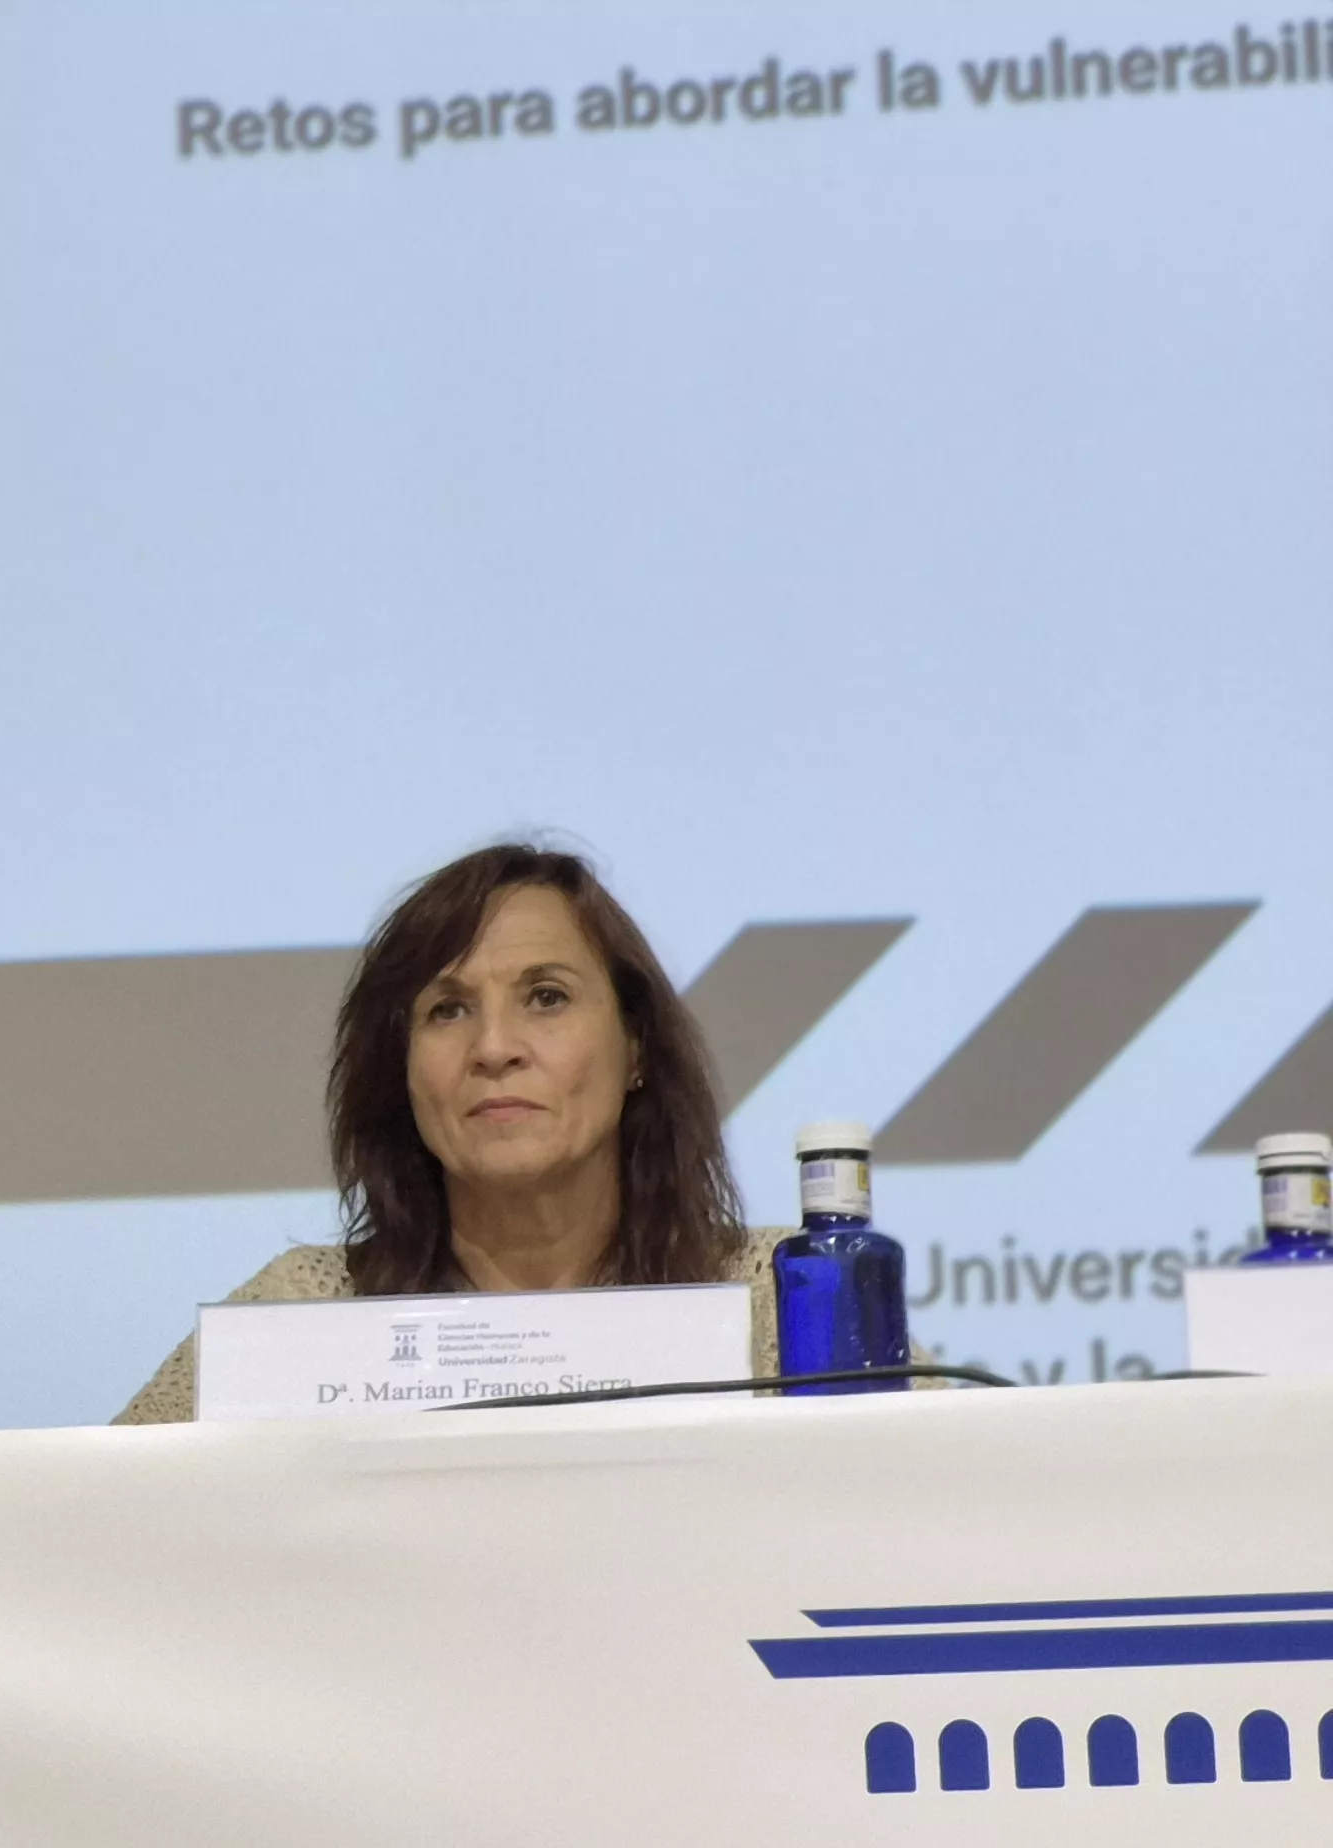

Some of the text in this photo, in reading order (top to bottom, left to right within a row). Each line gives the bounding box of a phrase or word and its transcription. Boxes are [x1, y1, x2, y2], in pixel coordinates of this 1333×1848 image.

[176, 97, 376, 160] Retos
[399, 87, 555, 162] para
[575, 57, 855, 134] abordar
[876, 48, 940, 114] la
[438, 1354, 508, 1367] Universidad
[364, 1381, 453, 1402] Marian
[463, 1377, 549, 1399] Franco
[557, 1374, 633, 1393] Sierra
